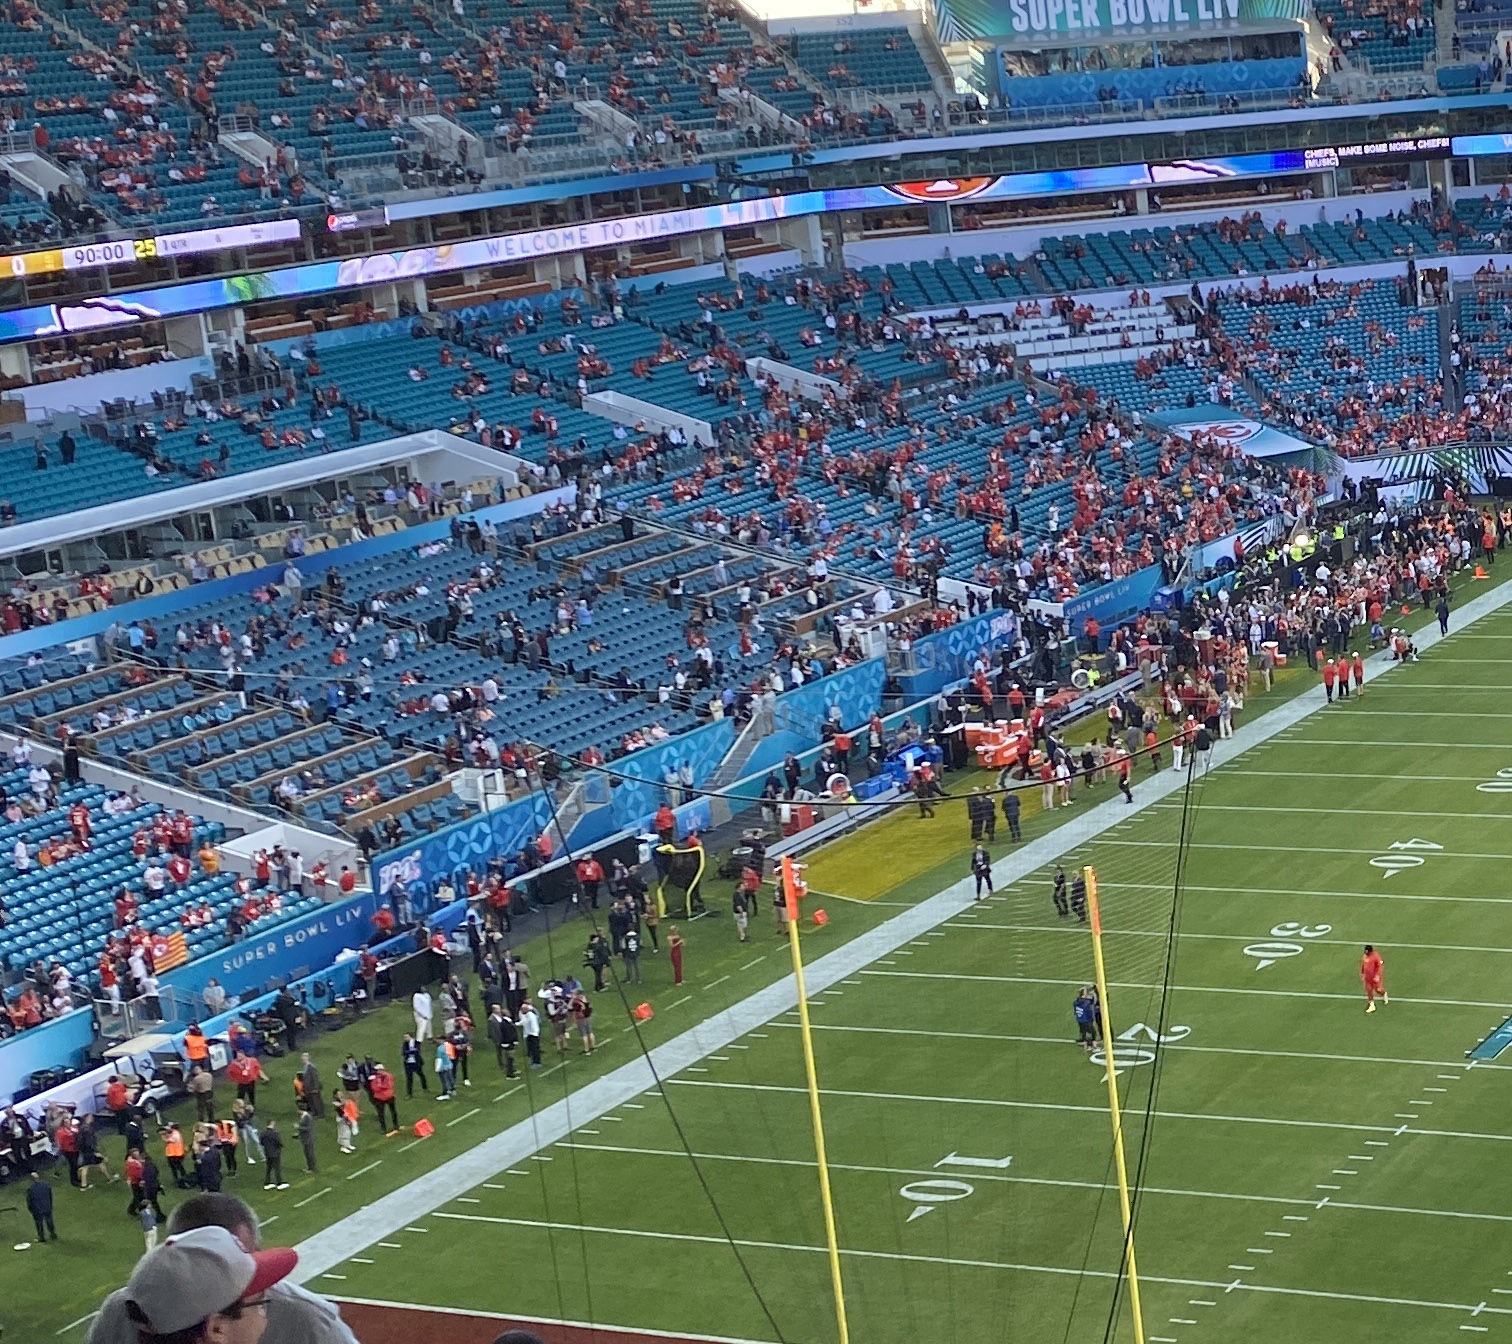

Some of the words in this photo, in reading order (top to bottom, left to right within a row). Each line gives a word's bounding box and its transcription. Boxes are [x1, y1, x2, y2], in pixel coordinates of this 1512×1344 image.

[1304, 148, 1338, 159] CHIEFS,
[1338, 145, 1363, 156] MAKE
[1363, 143, 1388, 154] SOME
[1388, 140, 1417, 152] NOISE,
[1417, 137, 1450, 149] CHIEFS!
[135, 238, 156, 258] 25
[486, 229, 589, 257] WELCOME
[603, 223, 625, 241] TO
[634, 214, 697, 238] MIAMI
[75, 243, 125, 267] 90:00
[223, 942, 277, 974] SUPER
[284, 923, 328, 948] BOWL
[336, 906, 363, 927] LIV
[899, 1151, 1013, 1203] 10
